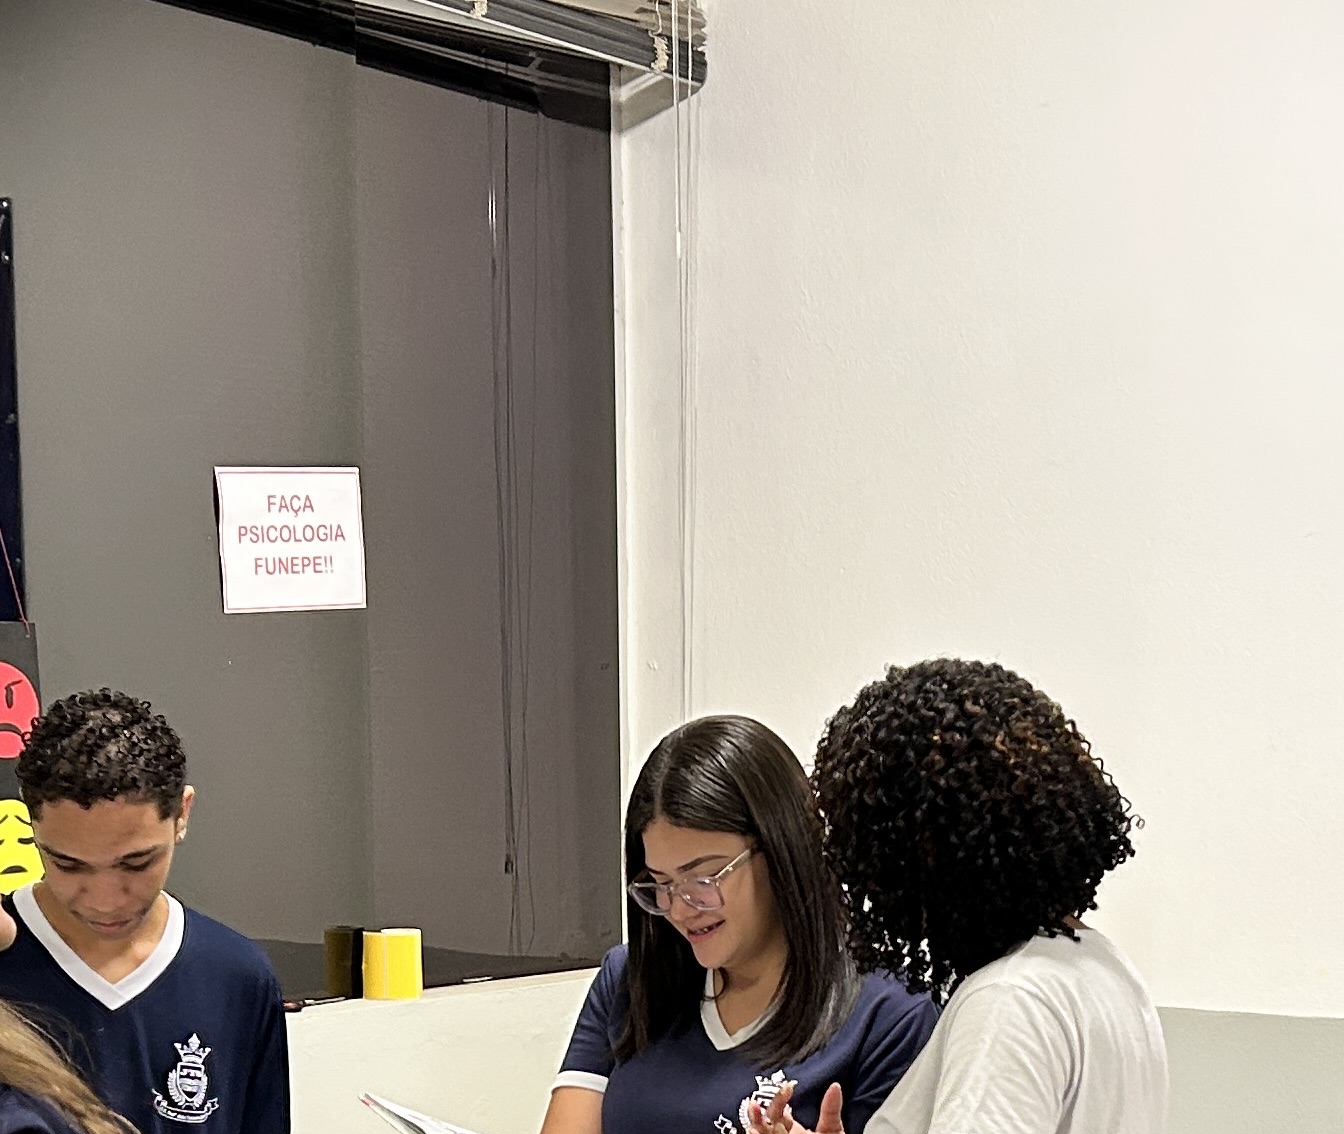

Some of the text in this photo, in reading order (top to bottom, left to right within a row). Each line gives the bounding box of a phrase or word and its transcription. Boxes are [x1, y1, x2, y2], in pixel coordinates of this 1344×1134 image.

[266, 494, 315, 518] FAÇA
[237, 523, 347, 544] PSICOLOGIA
[253, 554, 335, 576] FUNEPE!!
